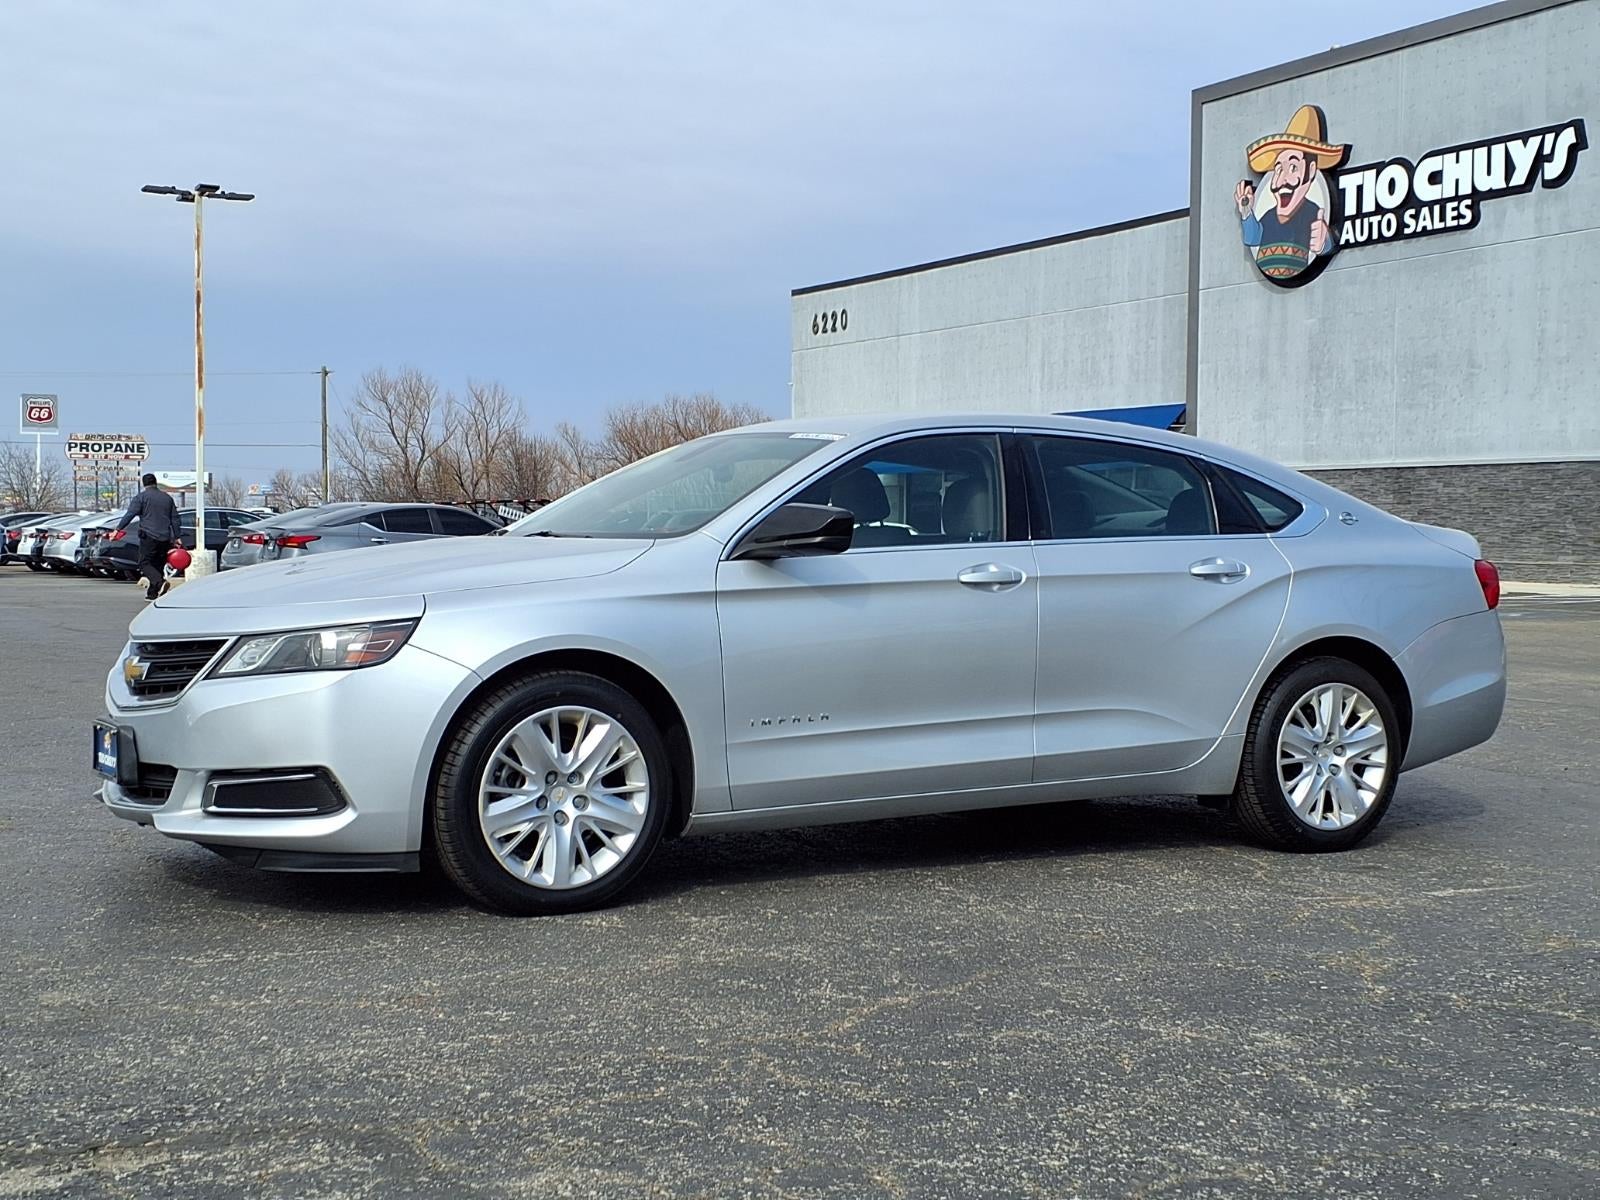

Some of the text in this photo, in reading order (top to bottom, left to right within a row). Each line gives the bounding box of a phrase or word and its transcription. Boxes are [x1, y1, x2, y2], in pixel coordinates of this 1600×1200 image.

[1339, 126, 1577, 217] TIO CHUY'S
[1340, 199, 1473, 245] AUTO SALES
[812, 308, 848, 336] 6220
[31, 407, 50, 419] 66
[67, 442, 146, 453] PROPANE
[750, 713, 829, 727] IMPALA
